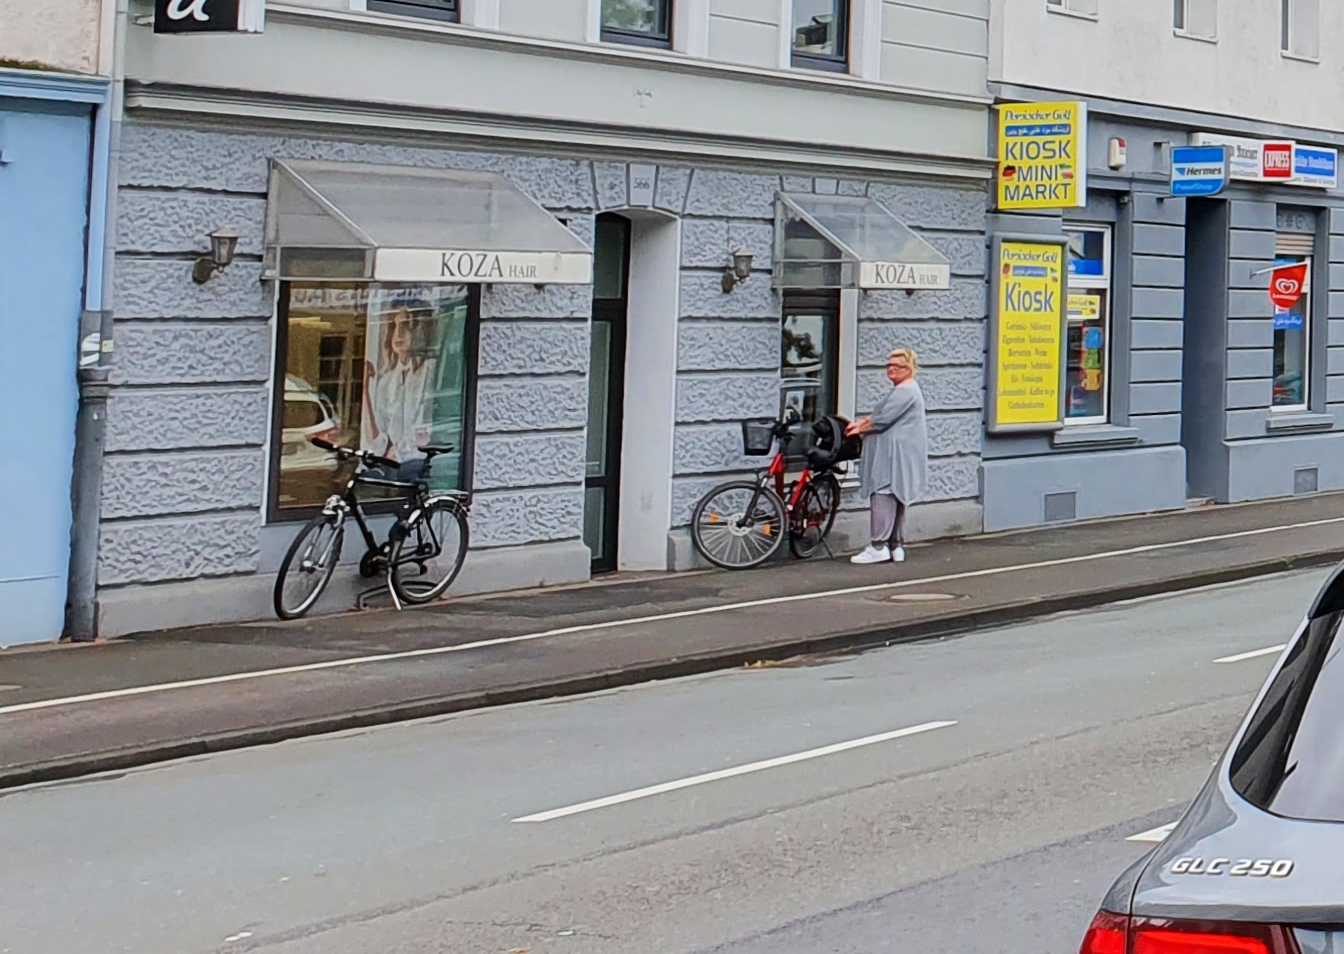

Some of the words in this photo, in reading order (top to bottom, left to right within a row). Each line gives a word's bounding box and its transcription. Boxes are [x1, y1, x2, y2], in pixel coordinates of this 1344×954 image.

[1005, 140, 1071, 161] KIOSK
[1017, 165, 1058, 182] MINI
[1187, 167, 1222, 176] Hermes
[1004, 183, 1071, 201] MARKT
[440, 252, 504, 278] KOZA
[509, 264, 537, 278] HAIR
[875, 264, 916, 285] KOZA
[1005, 283, 1054, 313] Kiosk
[1171, 857, 1230, 875] GLC
[1229, 859, 1295, 878] 250
